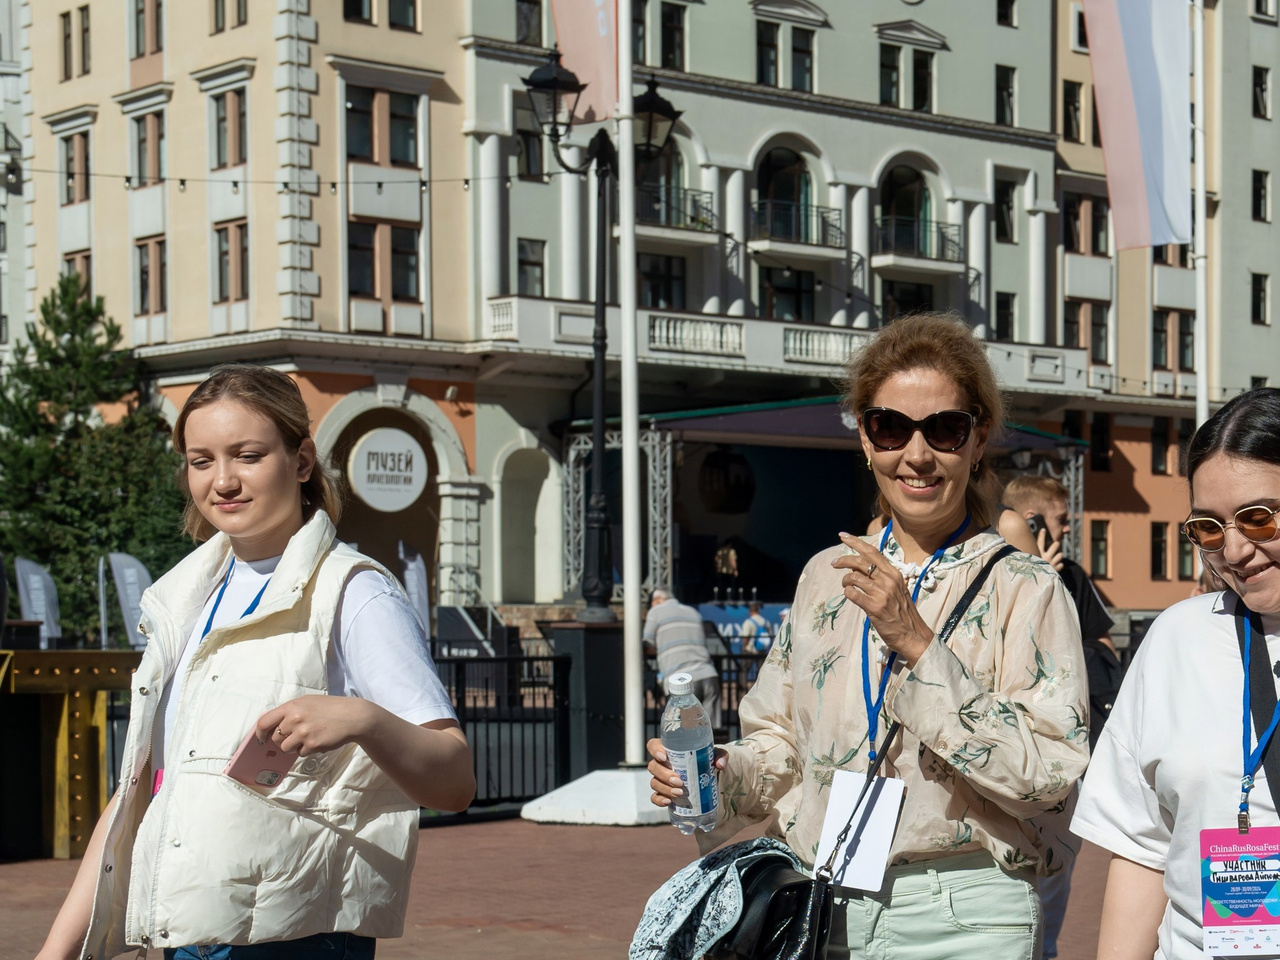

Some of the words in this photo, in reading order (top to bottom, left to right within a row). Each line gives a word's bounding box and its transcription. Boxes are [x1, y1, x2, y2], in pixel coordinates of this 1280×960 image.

[367, 449, 414, 472] МУЗЕЙ
[1209, 843, 1280, 853] ChinaRusRosaFest
[1223, 860, 1267, 871] УЧАСТНИК
